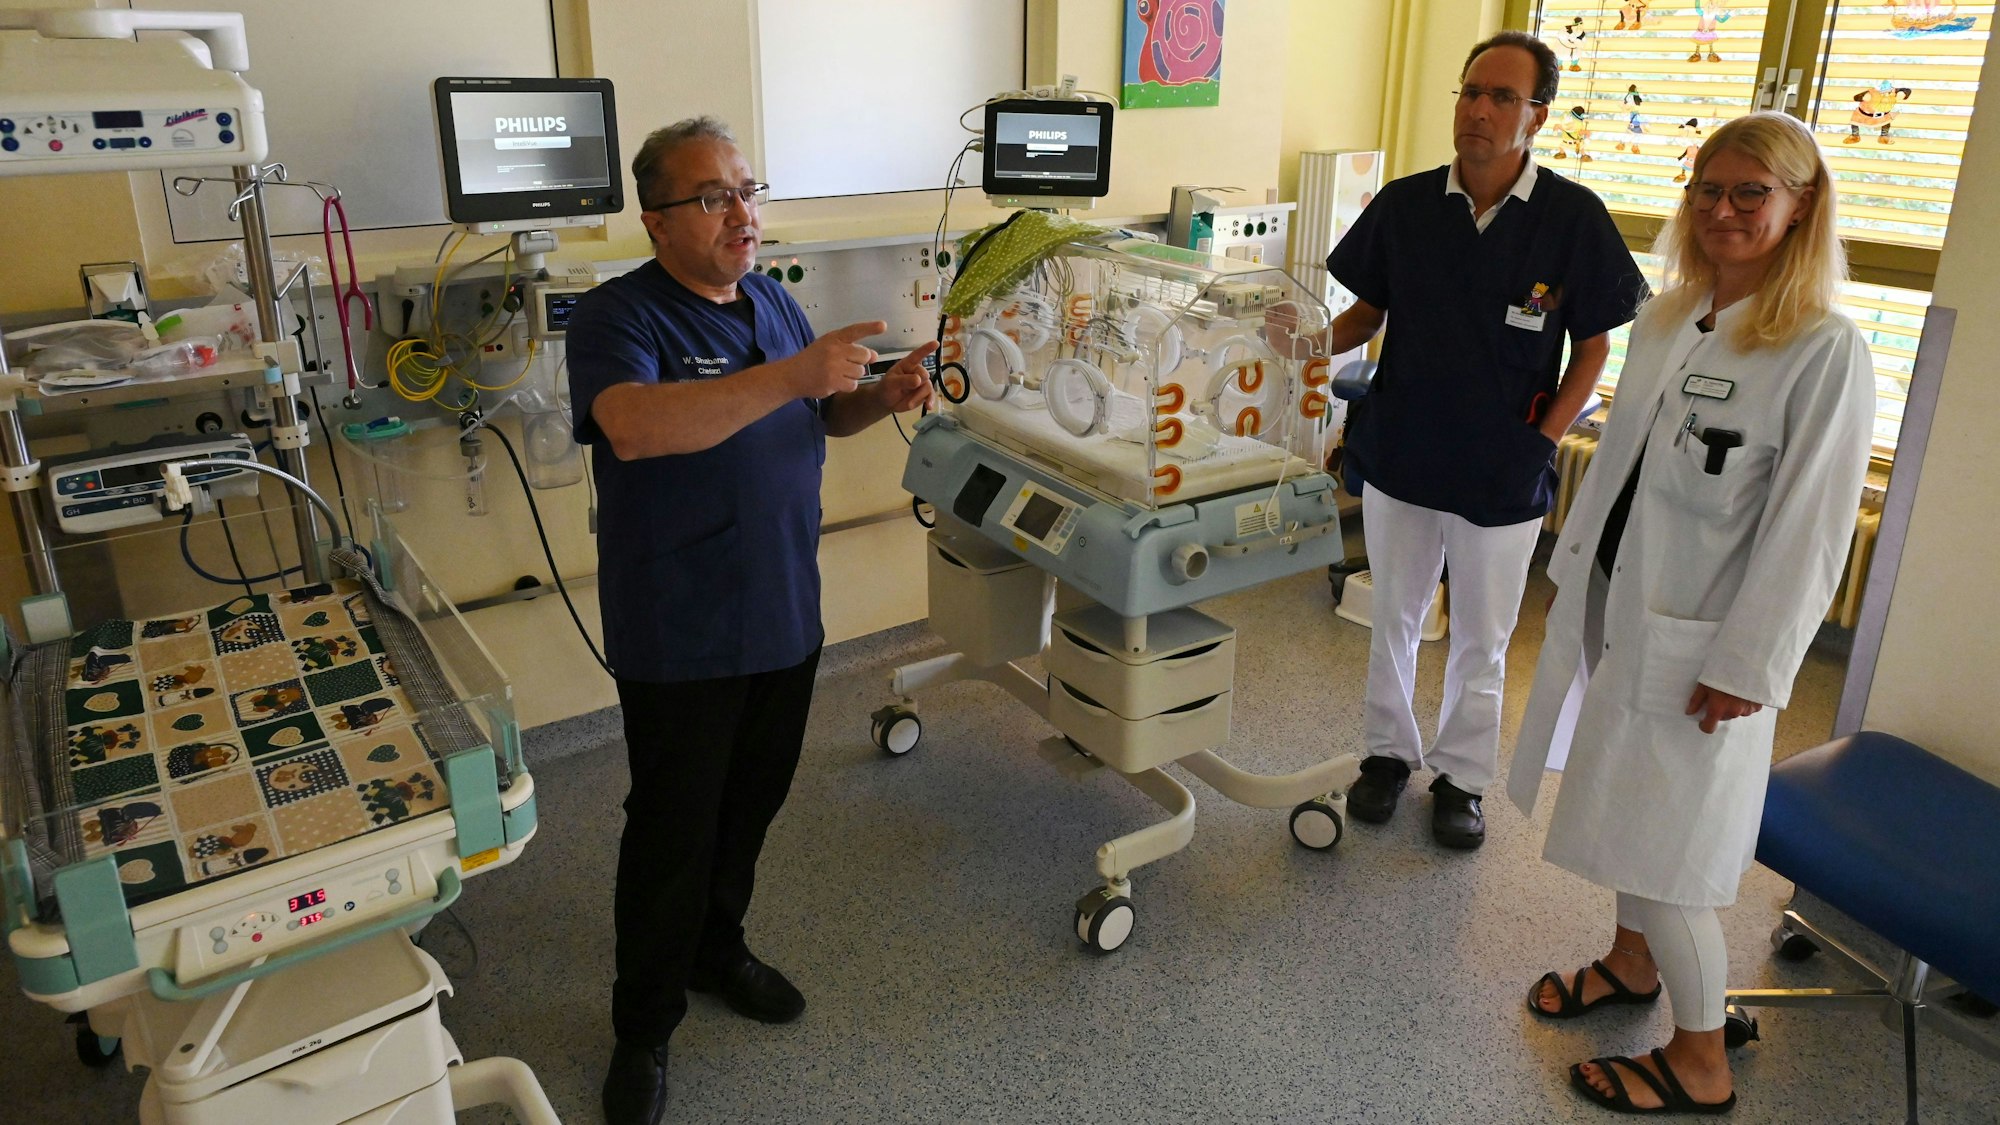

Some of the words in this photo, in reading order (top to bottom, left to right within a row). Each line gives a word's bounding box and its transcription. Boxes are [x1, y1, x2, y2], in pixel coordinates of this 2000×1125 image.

[495, 116, 567, 133] PHILIPS
[1028, 130, 1068, 140] PHILIPS
[682, 356, 694, 365] W.
[132, 496, 147, 505] BD
[66, 508, 81, 516] GH
[308, 1038, 322, 1047] 2kg
